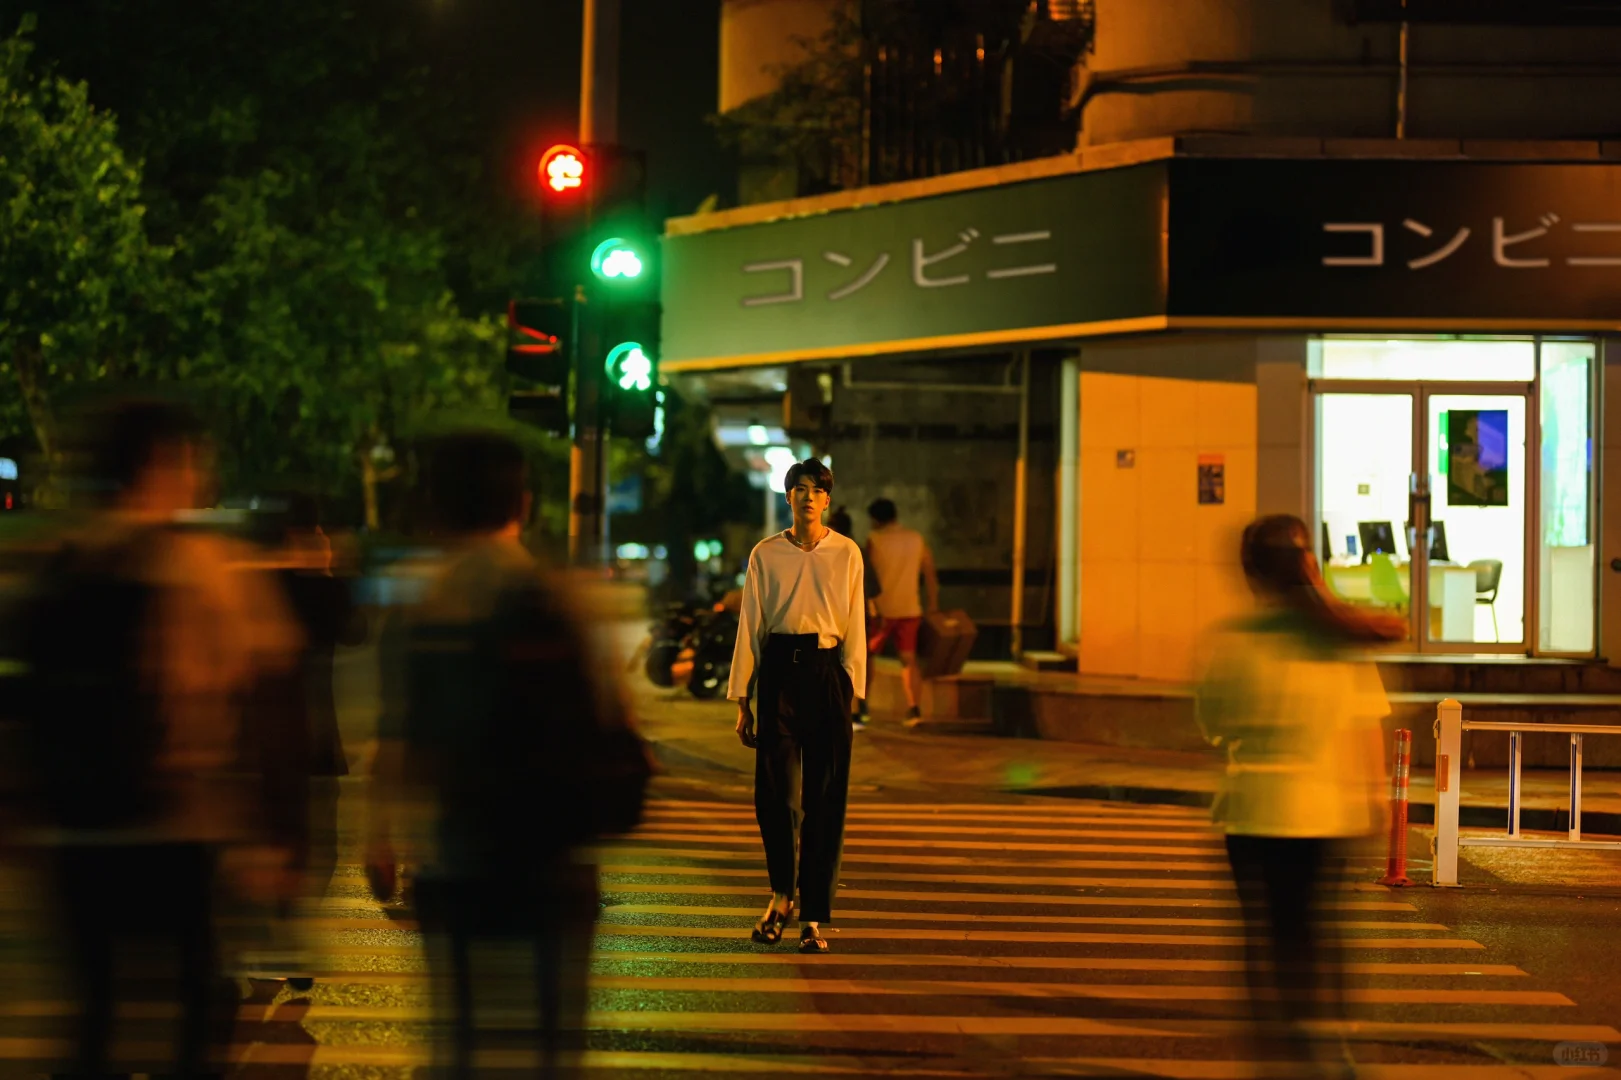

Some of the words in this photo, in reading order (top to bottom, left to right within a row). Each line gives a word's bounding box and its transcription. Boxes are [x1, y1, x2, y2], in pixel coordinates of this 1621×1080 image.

[743, 227, 1057, 307] コンビニ
[1322, 212, 1621, 269] コンビニ
